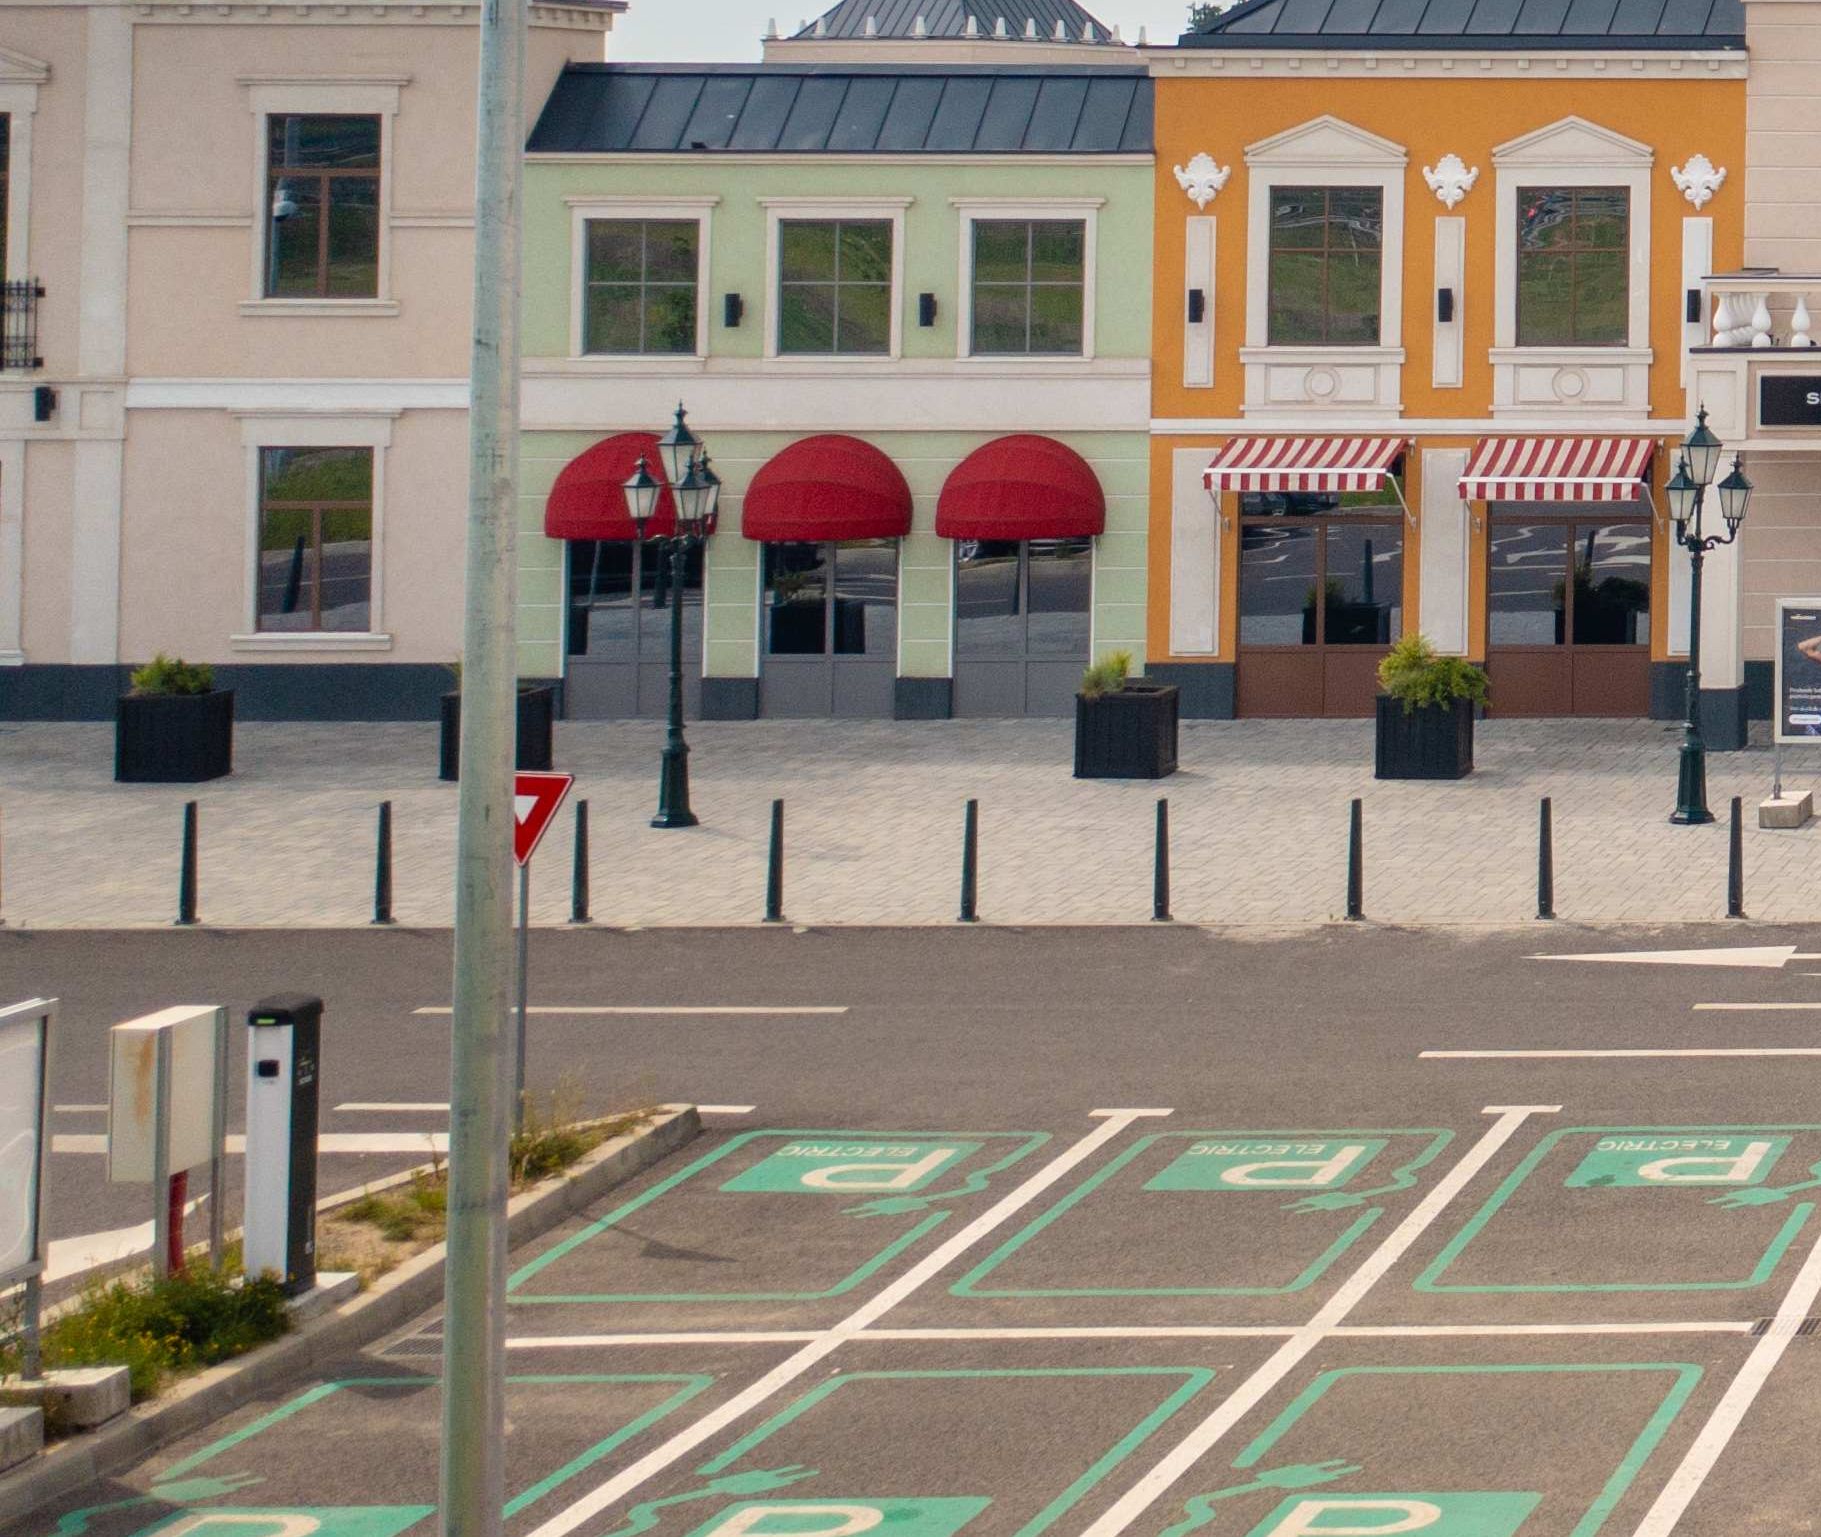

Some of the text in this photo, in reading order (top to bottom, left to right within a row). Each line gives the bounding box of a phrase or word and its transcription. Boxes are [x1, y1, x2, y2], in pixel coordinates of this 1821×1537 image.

[776, 1145, 920, 1157] ELECTRIC
[1188, 1144, 1327, 1155] ELECTRIC
[1597, 1139, 1733, 1151] ELECTRIC
[801, 1148, 959, 1189] P
[1220, 1145, 1366, 1185] P
[1637, 1142, 1773, 1181] P
